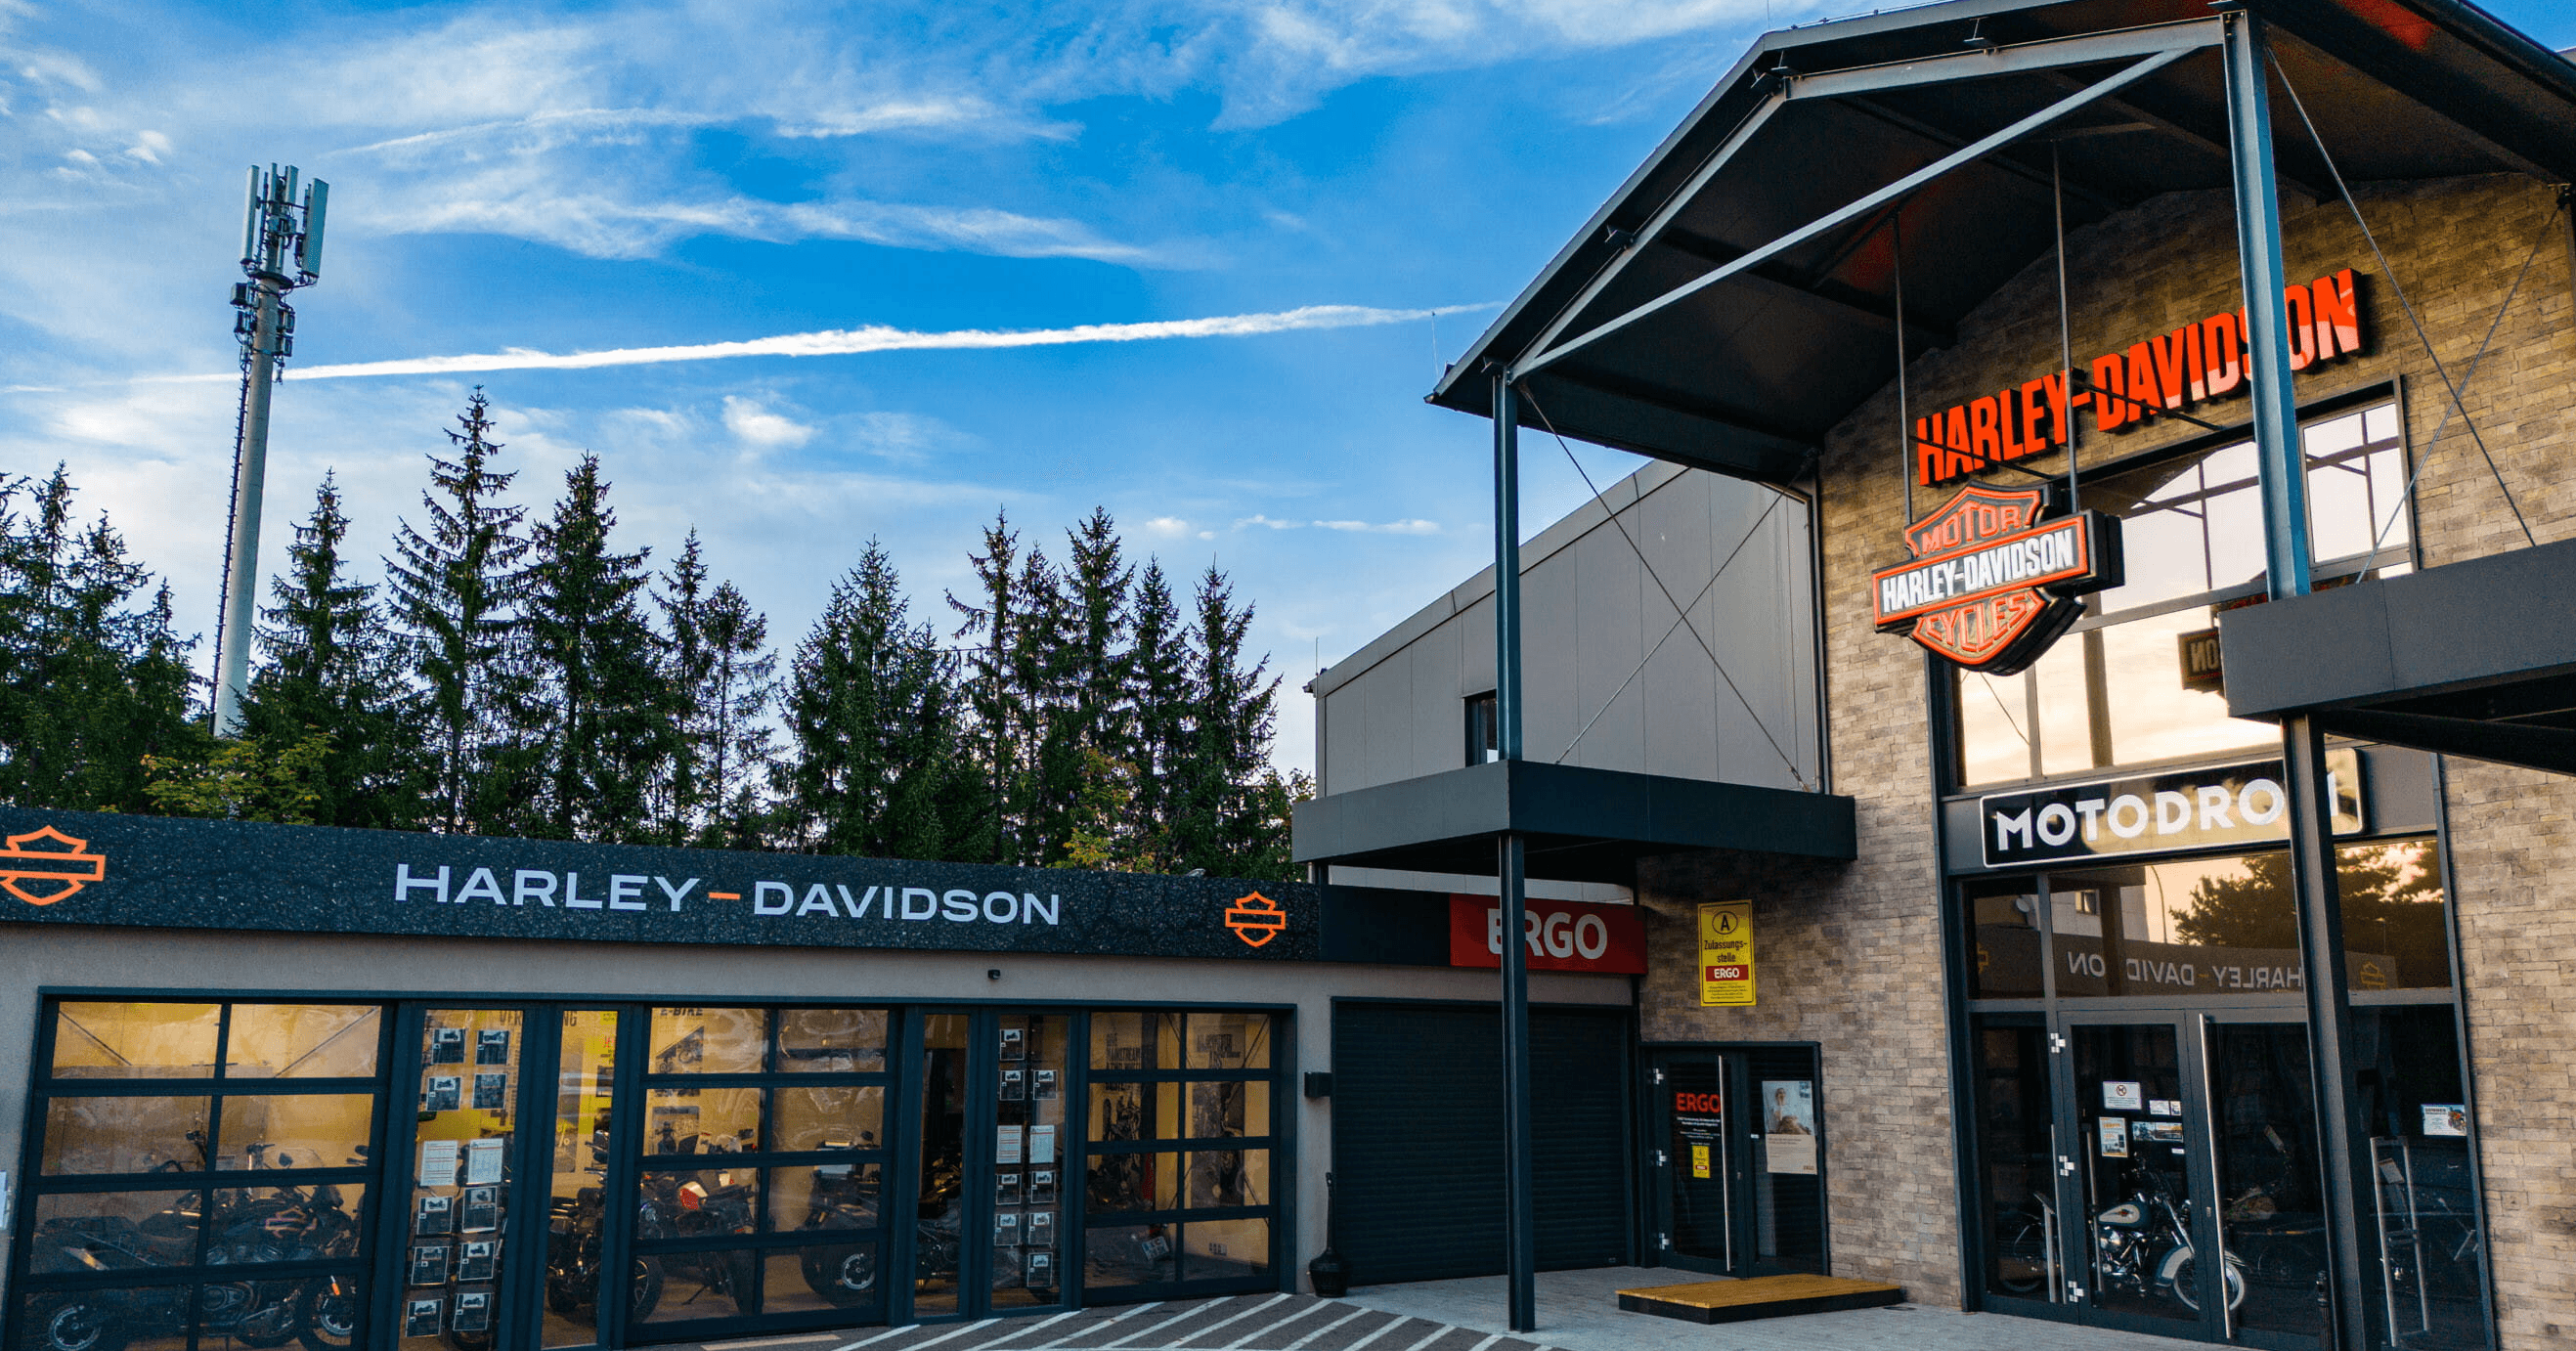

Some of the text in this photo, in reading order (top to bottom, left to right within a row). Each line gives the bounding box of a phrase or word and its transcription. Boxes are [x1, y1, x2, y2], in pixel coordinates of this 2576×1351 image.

[1917, 268, 2360, 486] HARLEY-DAVIDON
[1922, 501, 2022, 554] MOTOR
[1882, 529, 2074, 612] HARLEY-DAVIDSON
[1925, 592, 2029, 652] CYCLES
[1721, 914, 1730, 931] A
[1704, 939, 1748, 951] Zulassungs-
[1717, 952, 1736, 963] stelle
[1714, 968, 1739, 979] ERGO
[1676, 1092, 1721, 1113] ERGO
